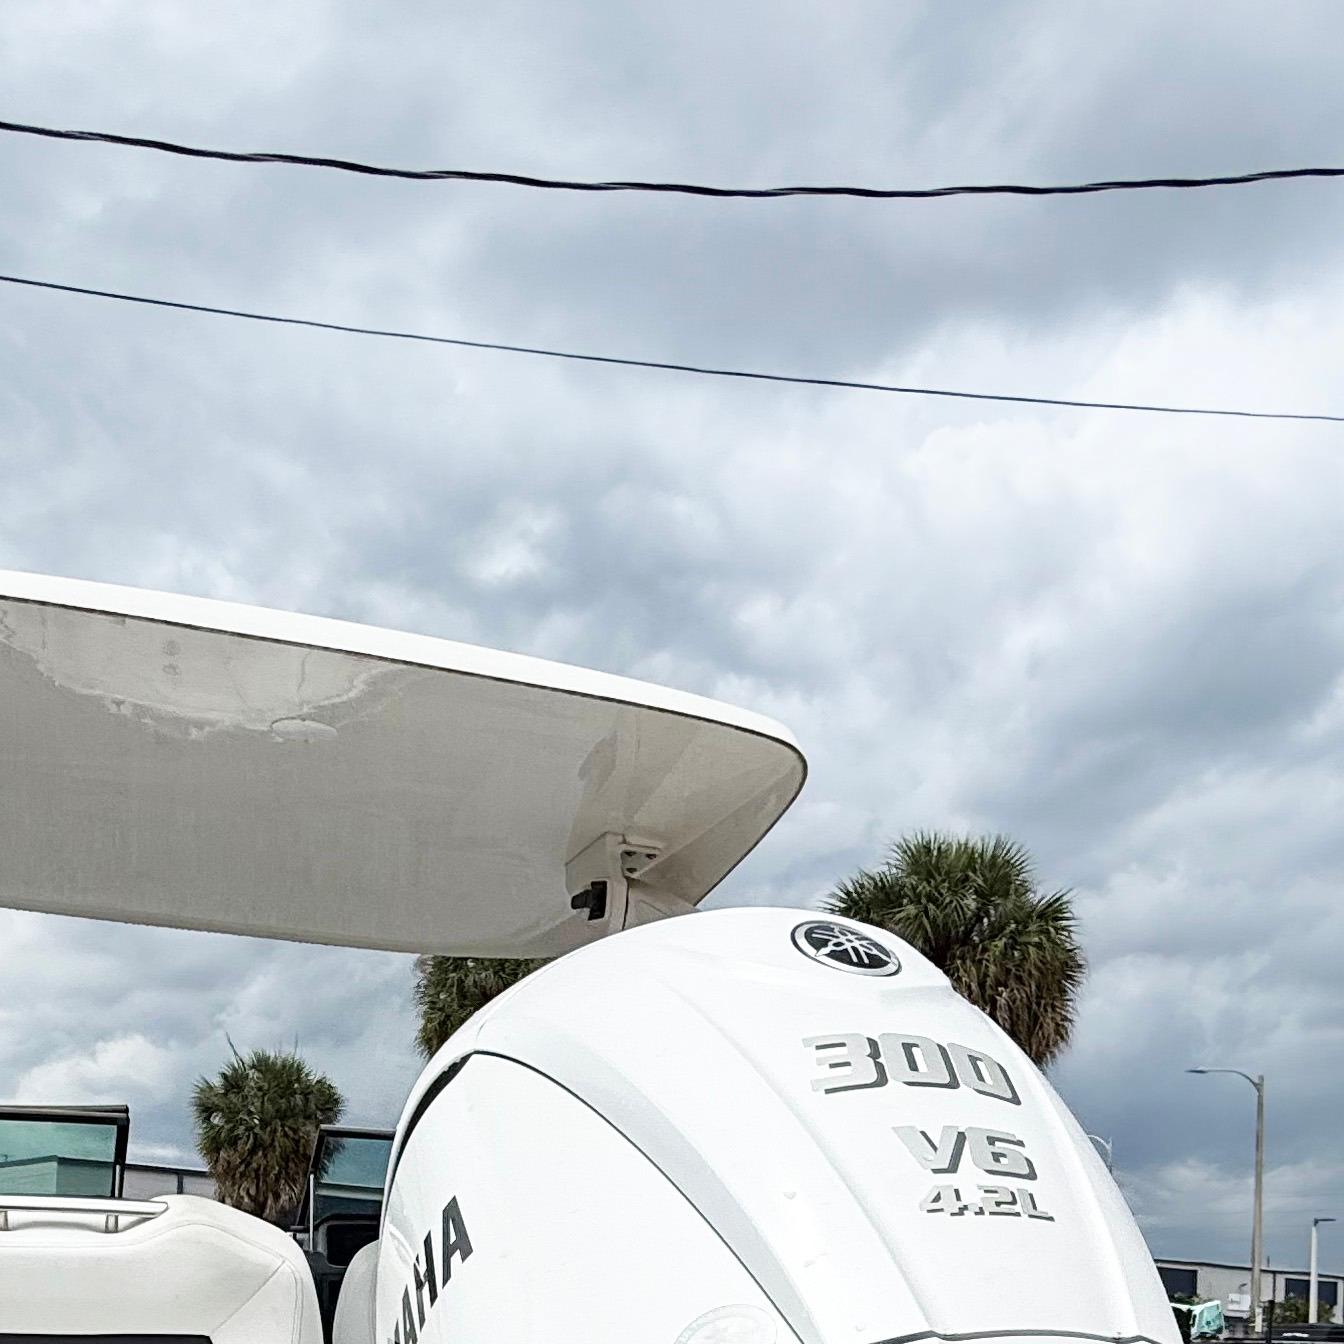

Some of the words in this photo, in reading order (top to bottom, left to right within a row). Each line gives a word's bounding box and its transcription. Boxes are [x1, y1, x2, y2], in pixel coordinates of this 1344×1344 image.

[802, 1033, 1022, 1106] 300
[891, 1125, 1038, 1181] V6
[919, 1184, 1056, 1222] 4.2L
